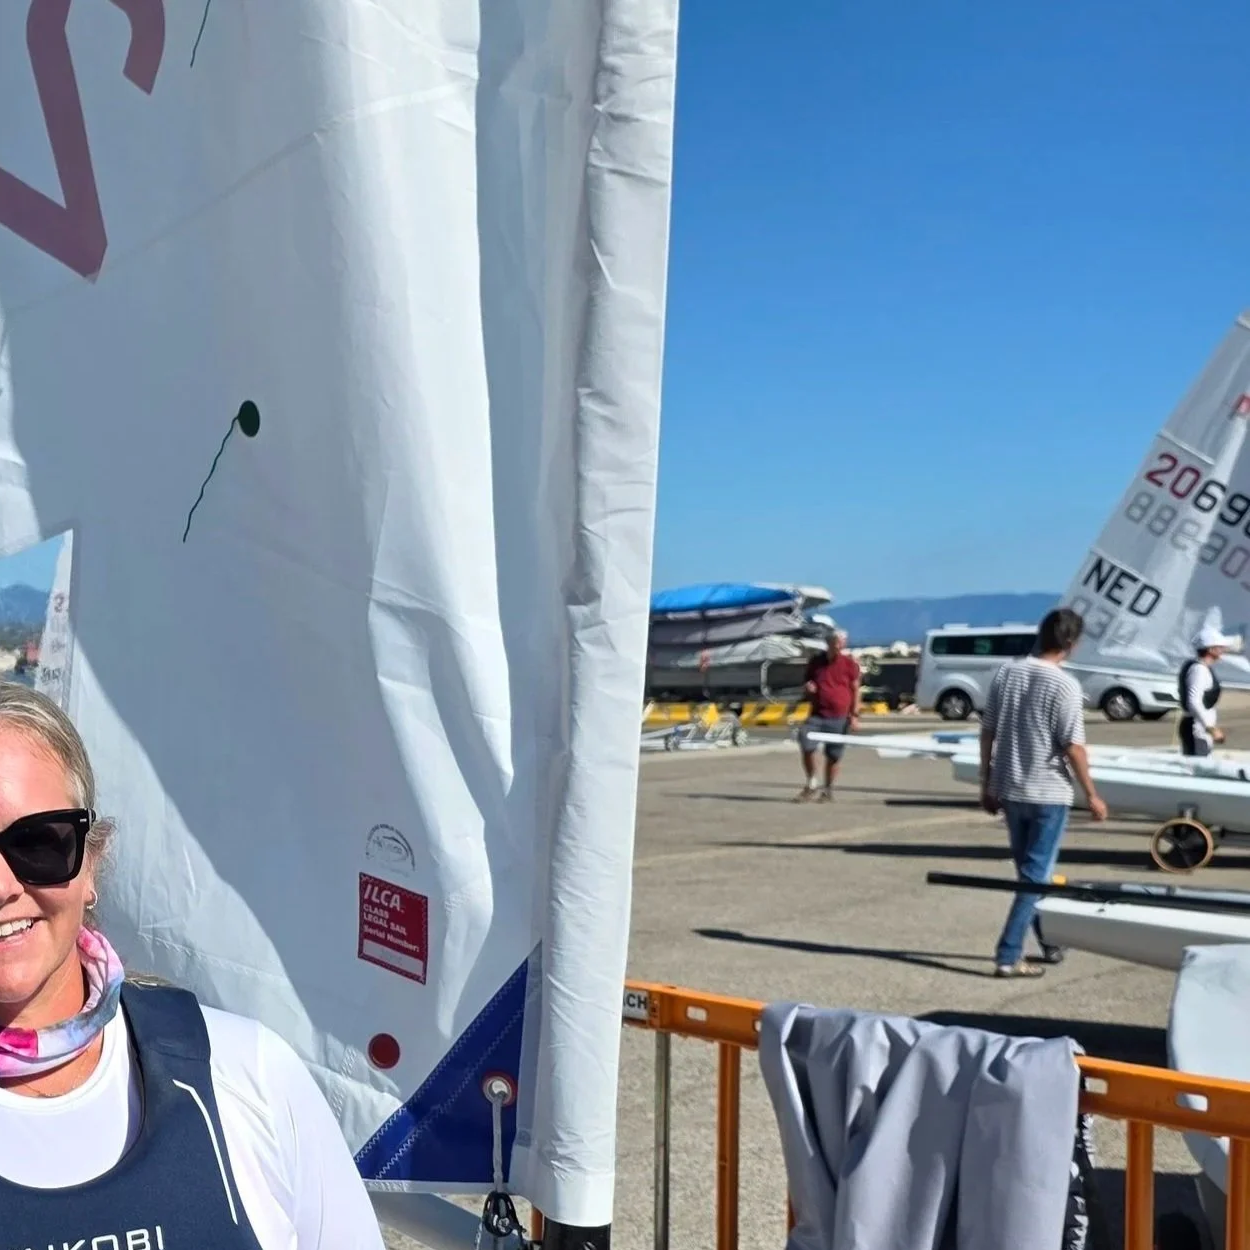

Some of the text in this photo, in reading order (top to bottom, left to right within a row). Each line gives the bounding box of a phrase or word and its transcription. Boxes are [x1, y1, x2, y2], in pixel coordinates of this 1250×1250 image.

[1082, 556, 1162, 617] NED
[363, 903, 390, 919] CLASS
[363, 912, 408, 936] LEGAL SAIL
[363, 924, 386, 939] Serial
[623, 993, 648, 1010] CH
